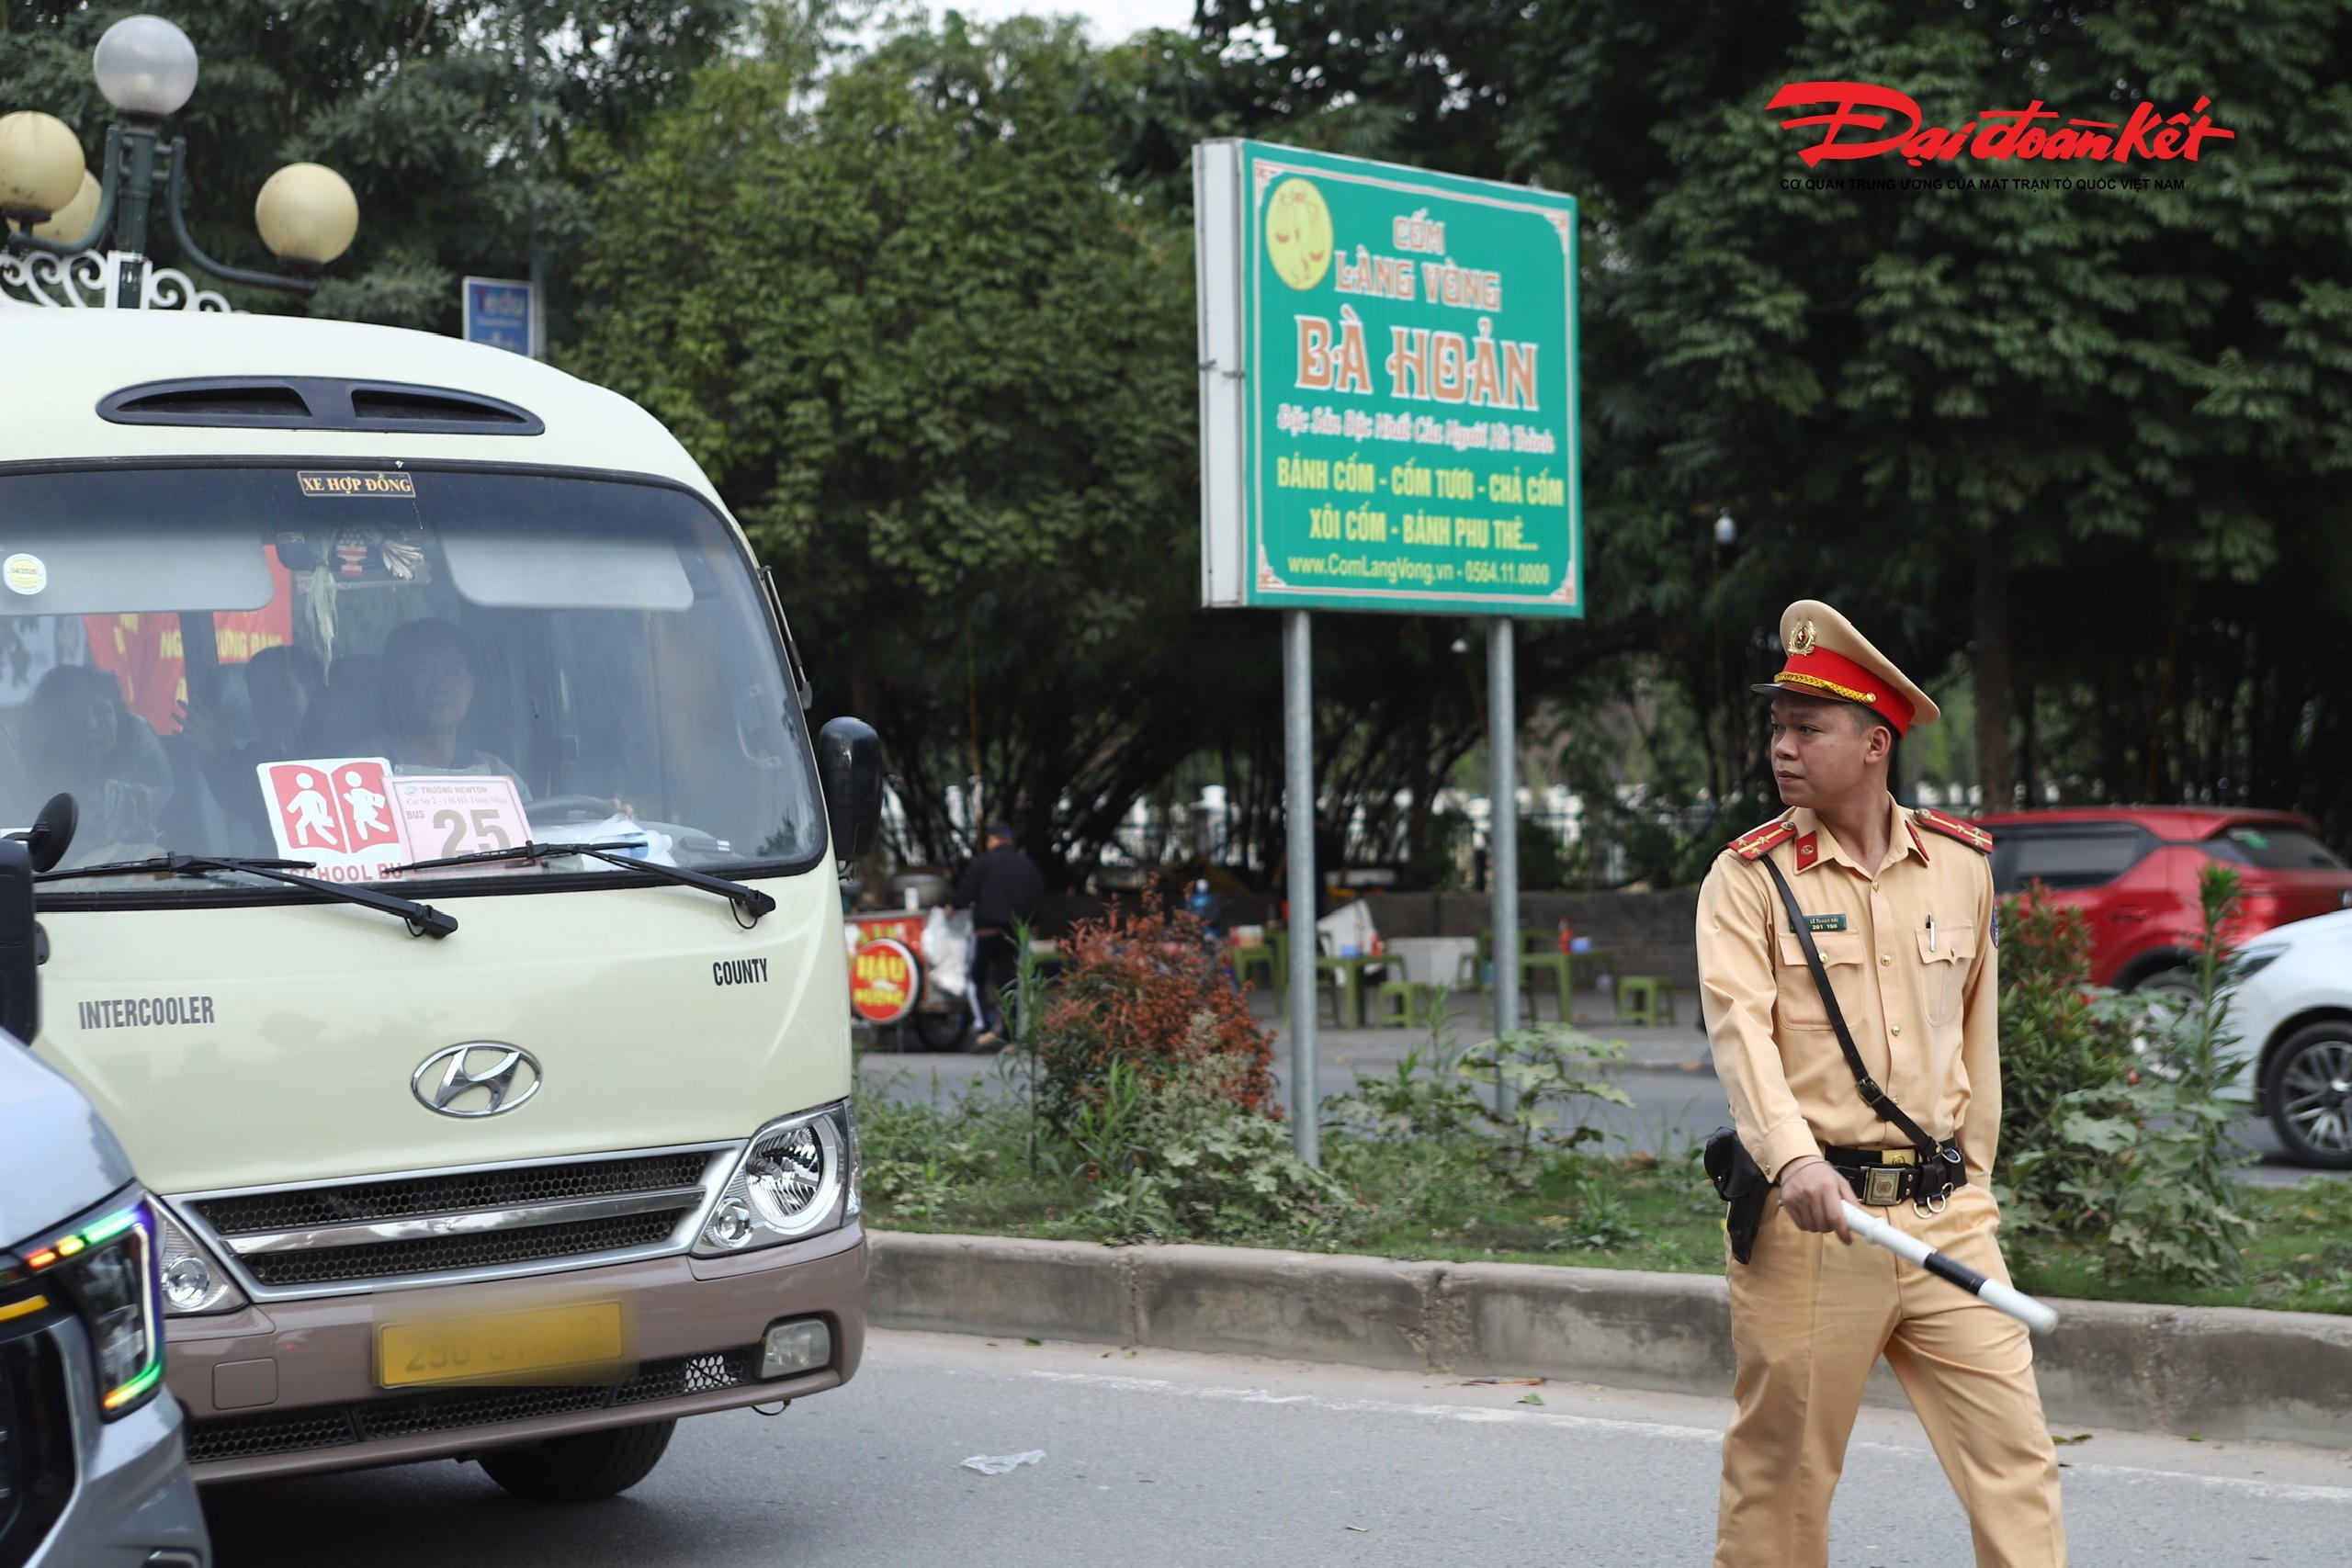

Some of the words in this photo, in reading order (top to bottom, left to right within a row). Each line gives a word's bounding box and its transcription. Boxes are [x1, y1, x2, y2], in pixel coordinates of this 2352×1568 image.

[1393, 208, 1445, 255] CỐM
[1334, 243, 1415, 301] LÀNG
[1420, 257, 1502, 312] VÒNG
[1294, 303, 1374, 395] BÀ
[1385, 317, 1539, 412] HOẢN
[302, 478, 324, 491] XE
[326, 476, 362, 494] HỢP
[365, 472, 412, 492] ĐỒNG
[1277, 451, 1329, 491] BÁNH
[1333, 452, 1375, 493] CỐM
[1391, 457, 1431, 498] CỐM
[1488, 466, 1523, 504] CHẢ
[1526, 468, 1565, 507] CỐM
[1308, 502, 1341, 540] XÔI
[1345, 501, 1387, 542] CỐM
[1403, 509, 1451, 547] BÁNH
[1288, 553, 1454, 586] www.ComLangVong.vn
[454, 785, 488, 794] NEWTON
[406, 810, 425, 820] BUS
[433, 808, 512, 858] 25
[377, 862, 404, 880] BU
[713, 958, 767, 986] COUNTY
[78, 996, 215, 1030] INTERCOOLER
